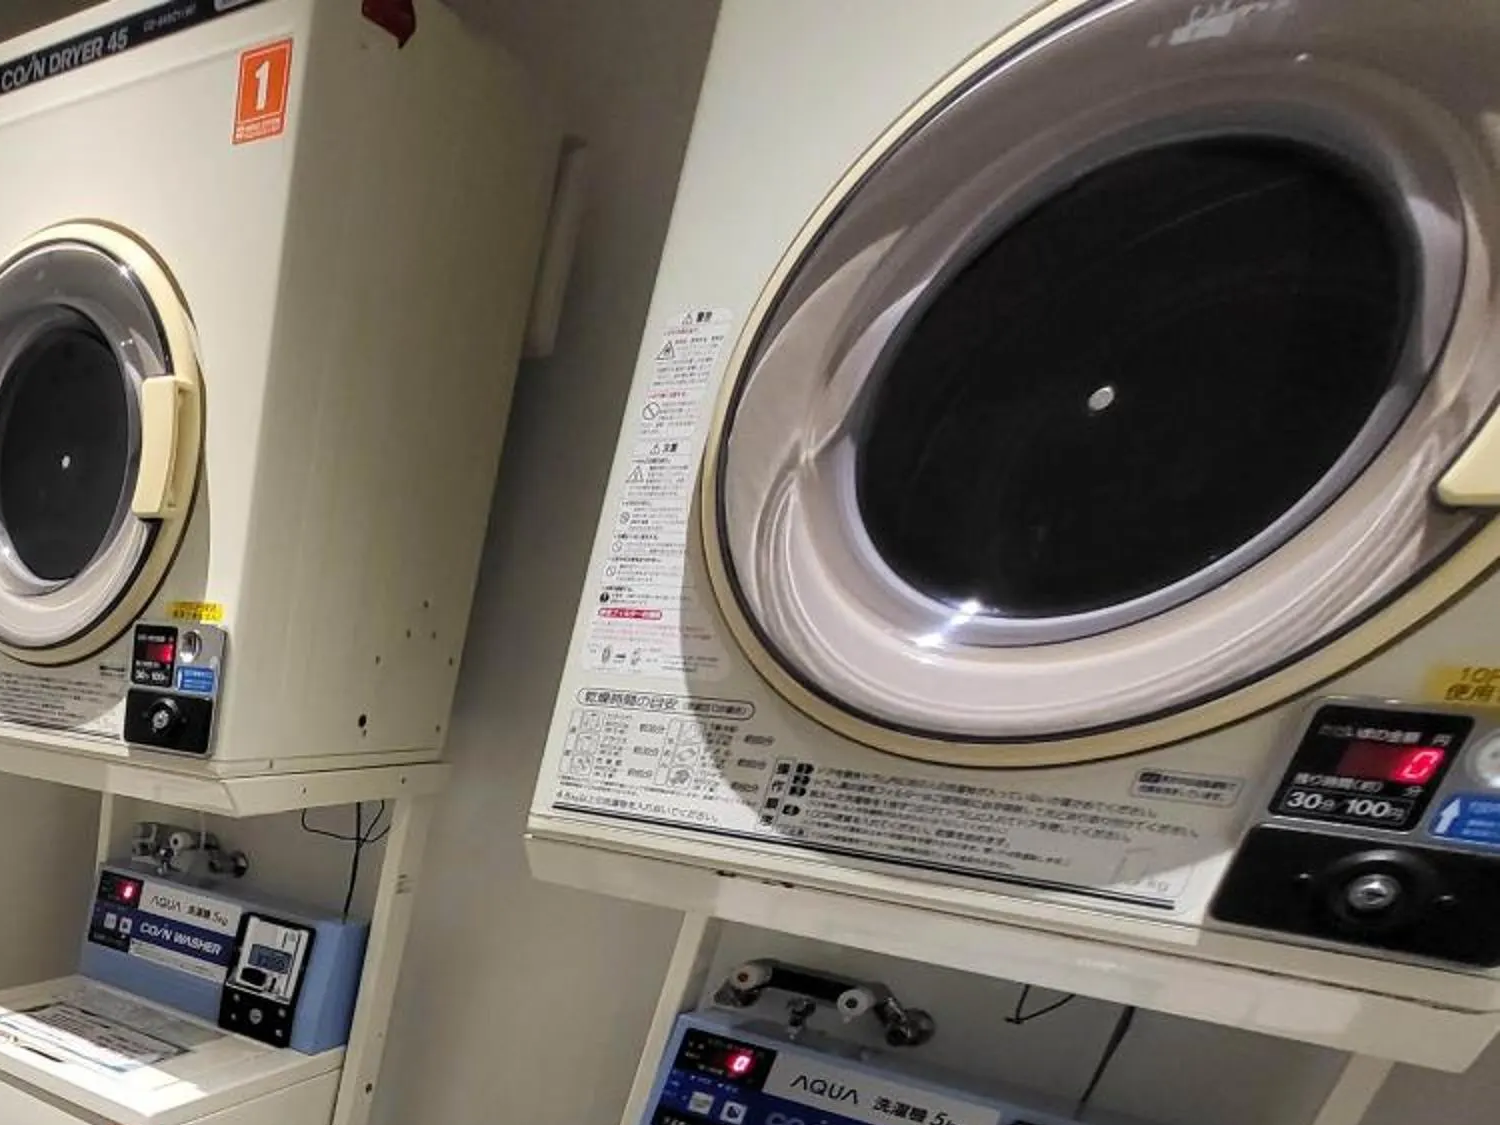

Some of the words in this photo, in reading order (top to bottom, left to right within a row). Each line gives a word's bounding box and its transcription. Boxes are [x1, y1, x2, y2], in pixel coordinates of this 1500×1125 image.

[50, 36, 104, 74] DRYER
[107, 26, 129, 55] 45
[255, 60, 271, 111] 1
[1402, 750, 1441, 780] 0
[173, 931, 223, 956] WASHER
[789, 1074, 859, 1105] AQUA
[872, 1095, 928, 1124] 洗濯機
